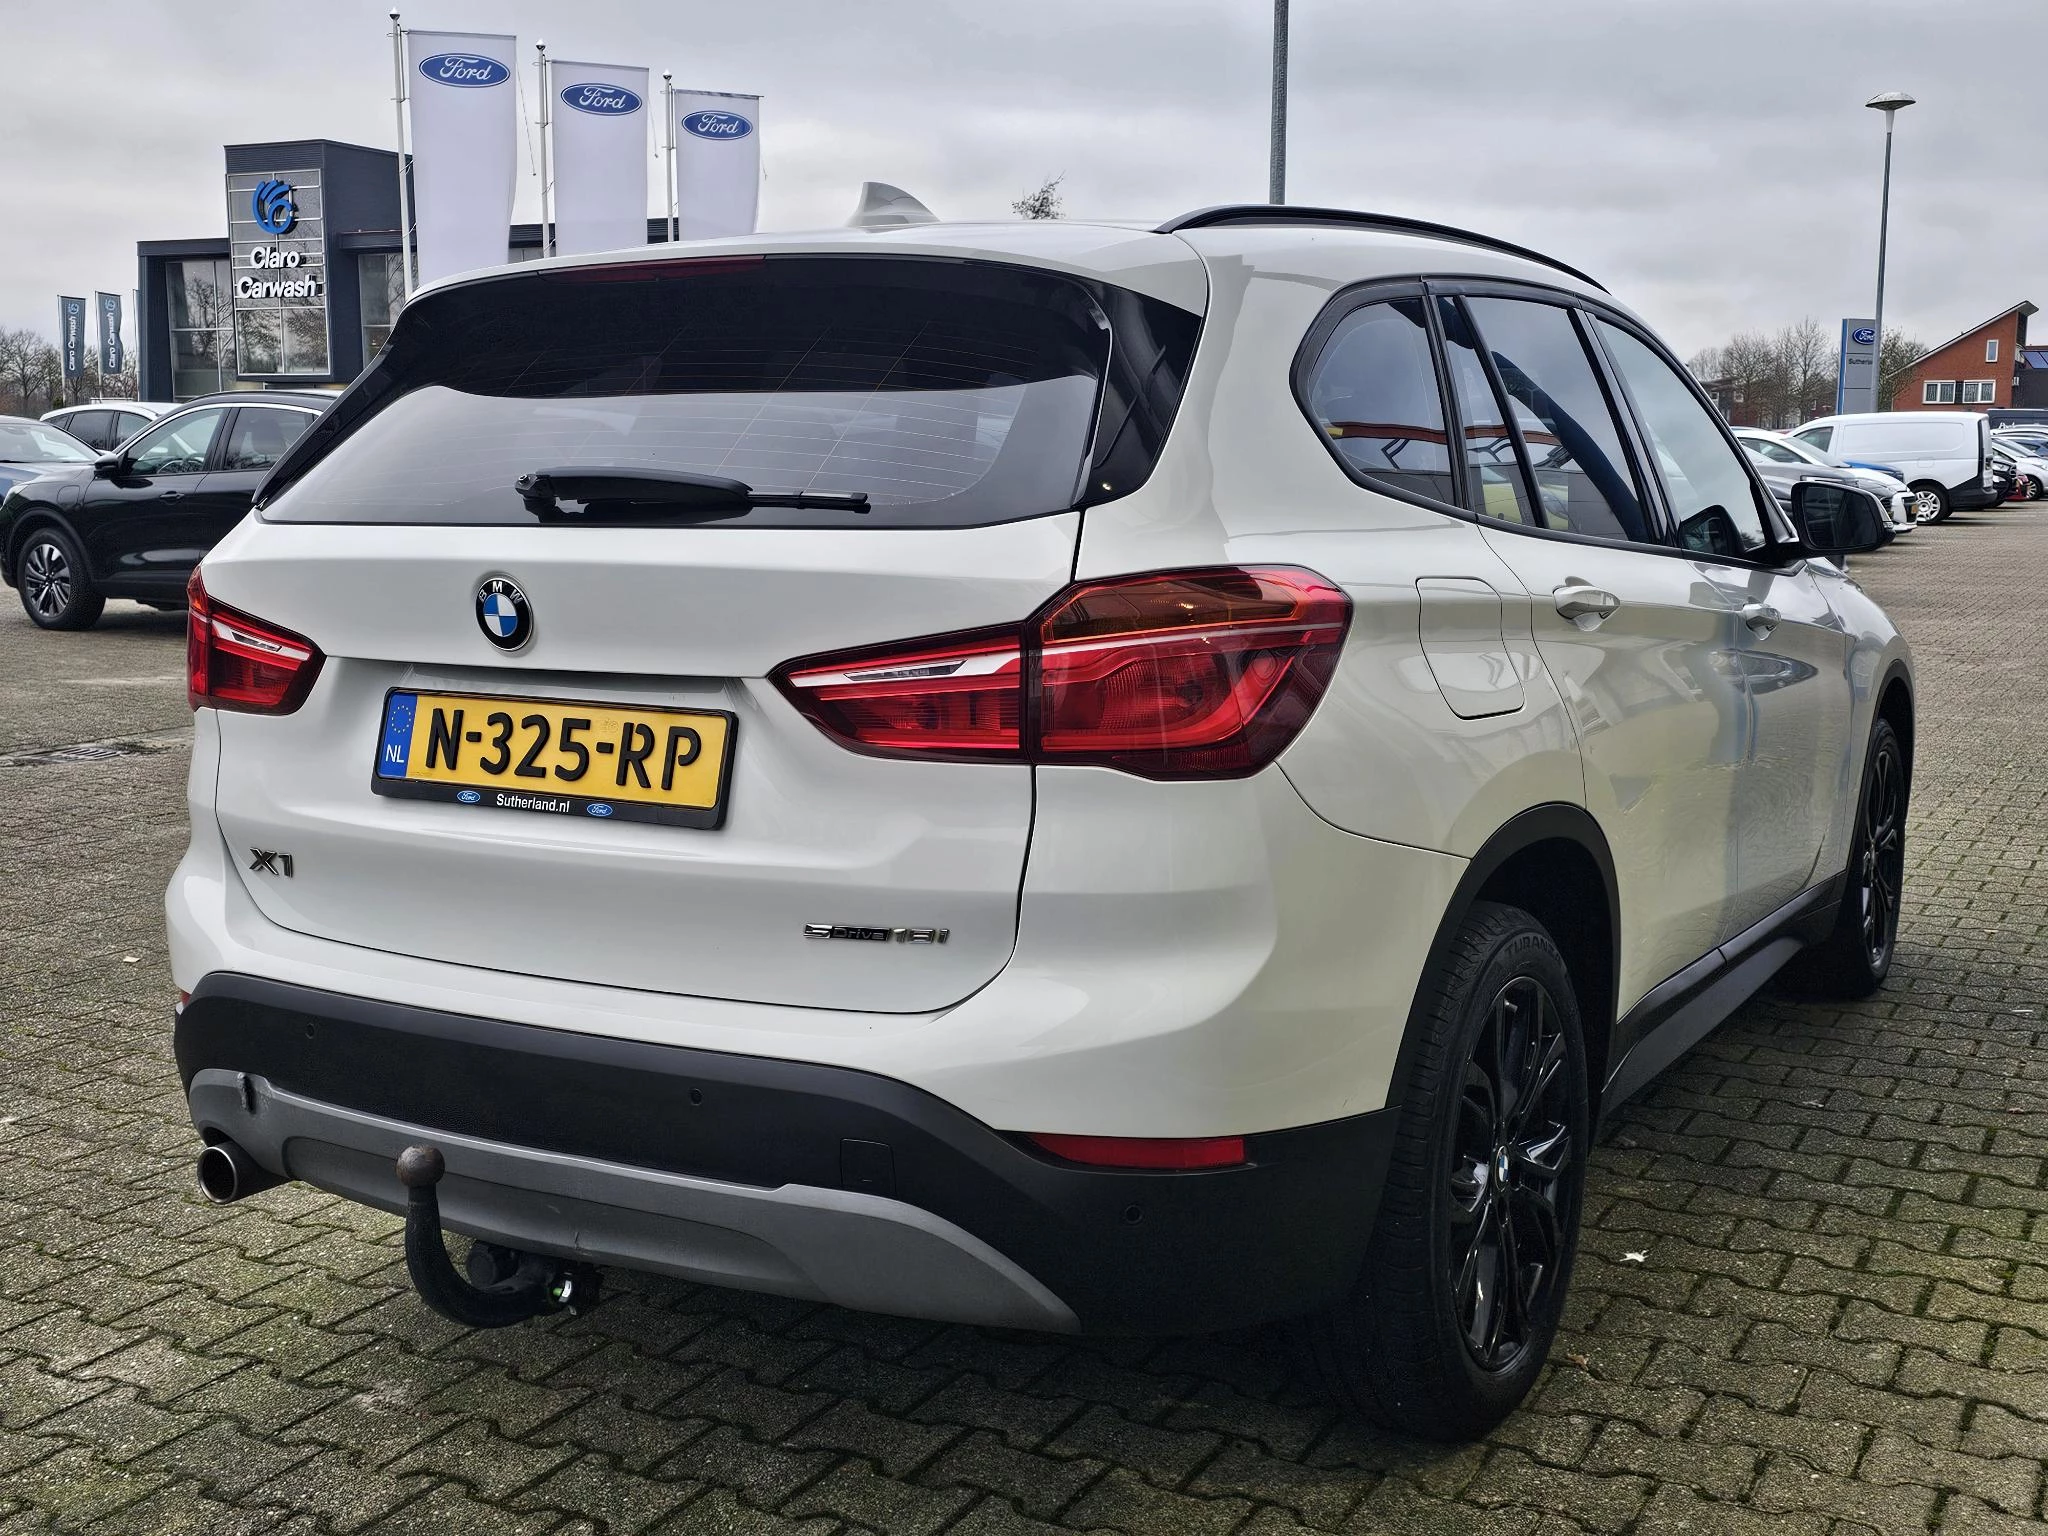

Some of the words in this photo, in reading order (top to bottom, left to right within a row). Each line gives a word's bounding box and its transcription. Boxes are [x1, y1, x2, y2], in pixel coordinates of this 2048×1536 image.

[440, 56, 491, 80] Ford
[579, 87, 626, 109] Ford
[698, 114, 739, 134] Ford
[250, 246, 300, 269] Claro
[237, 274, 317, 299] Carwash
[479, 580, 524, 604] BMW
[385, 744, 404, 763] NL
[425, 708, 702, 792] N-325-RP
[496, 793, 570, 813] Sutherland.nl
[248, 847, 294, 878] X1
